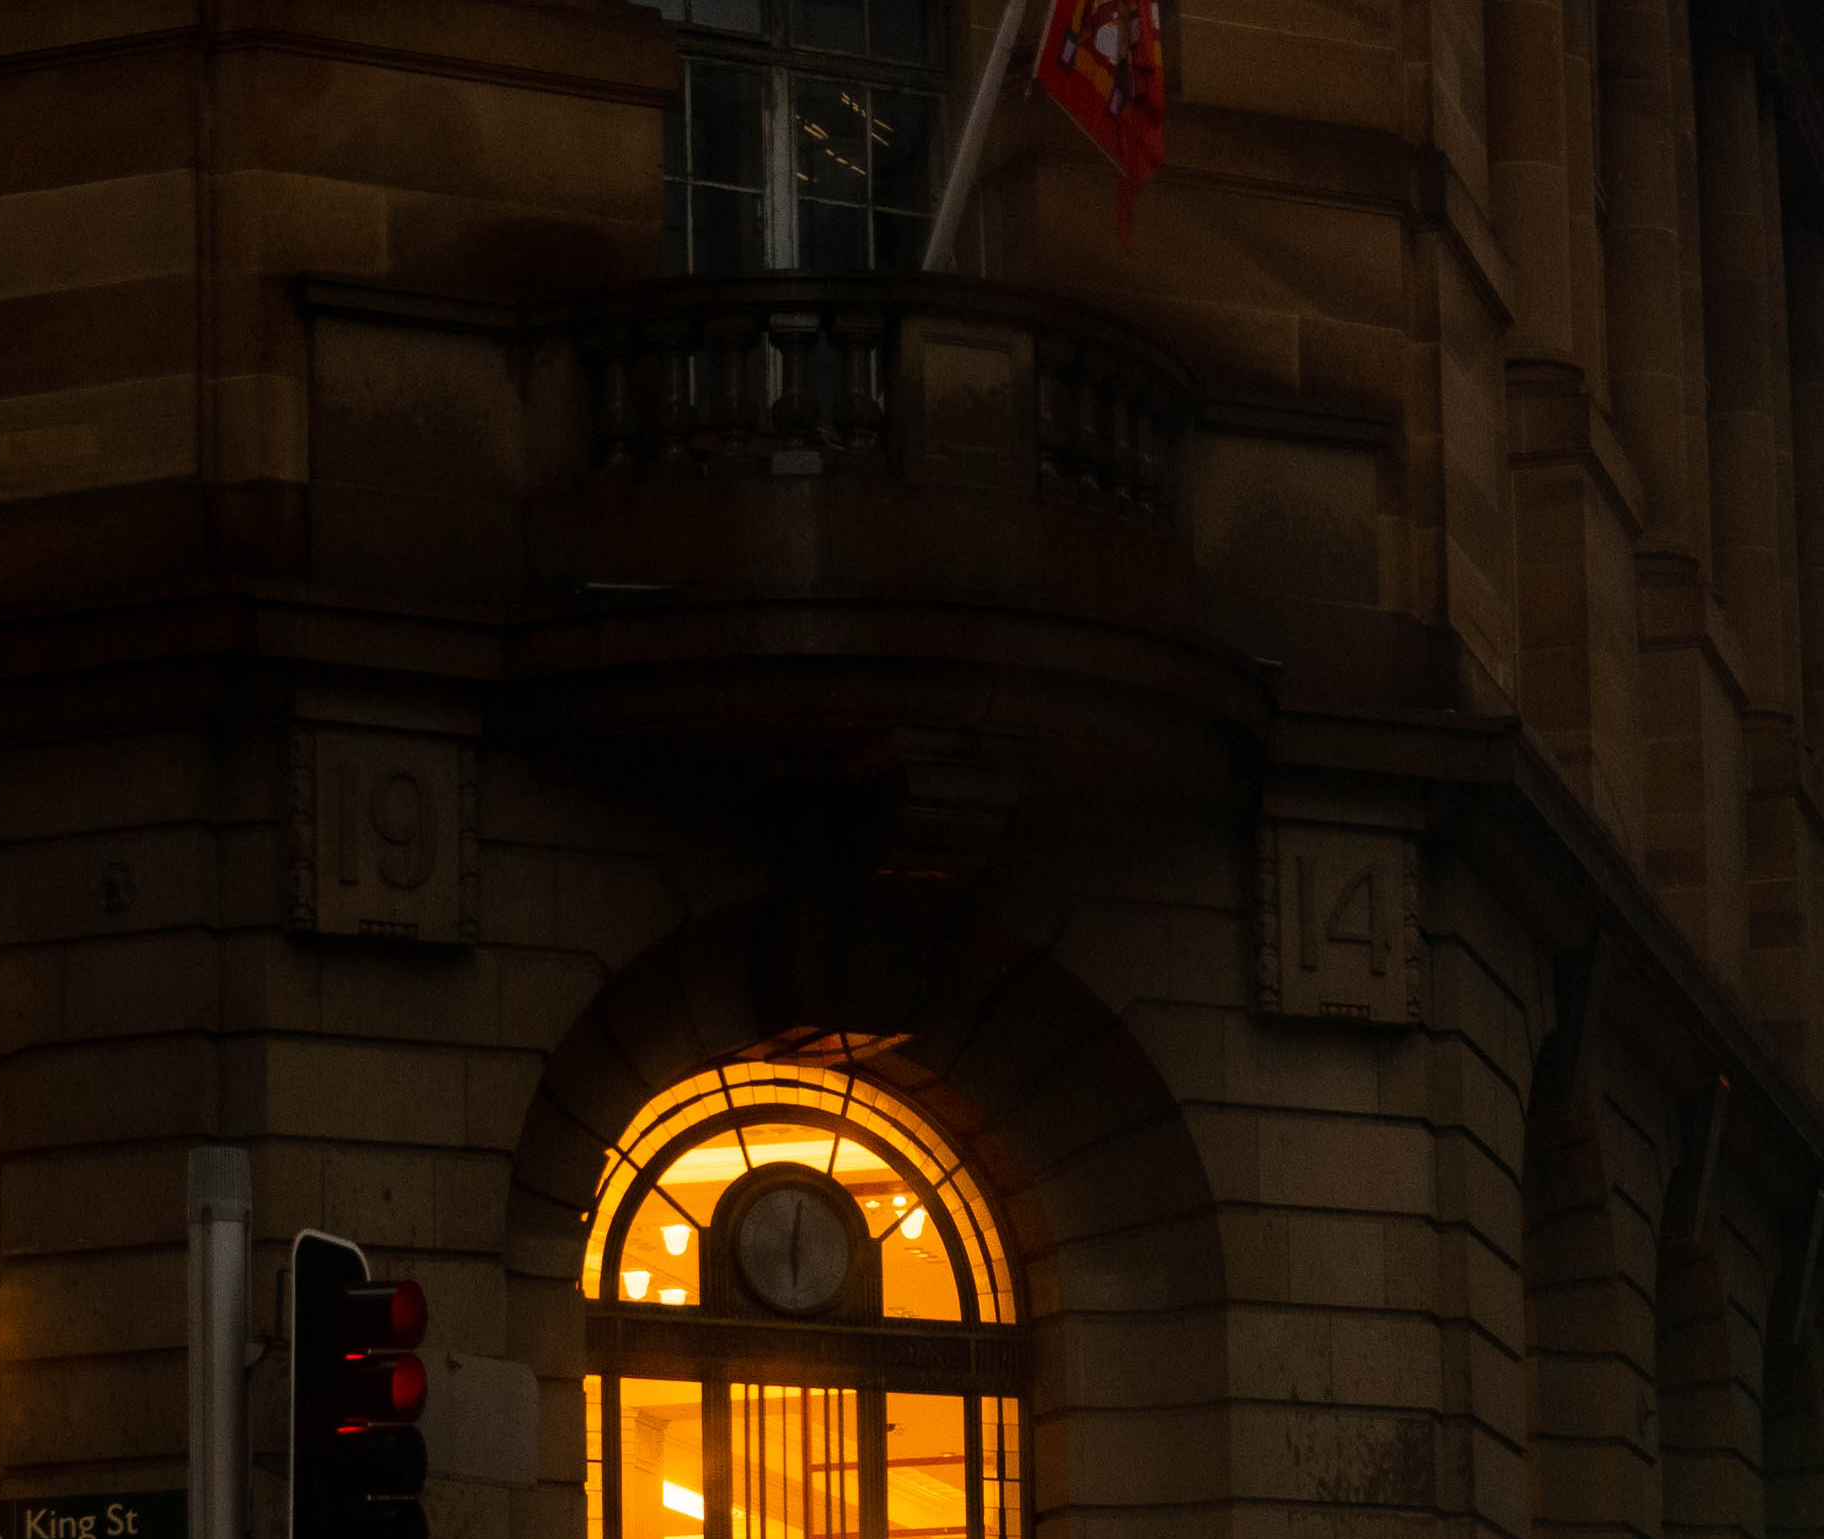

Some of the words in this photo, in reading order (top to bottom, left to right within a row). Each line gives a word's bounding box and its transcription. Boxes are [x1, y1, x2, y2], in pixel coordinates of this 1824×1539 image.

[338, 763, 436, 891] 19
[1296, 856, 1390, 976] 14
[106, 1503, 139, 1536] St
